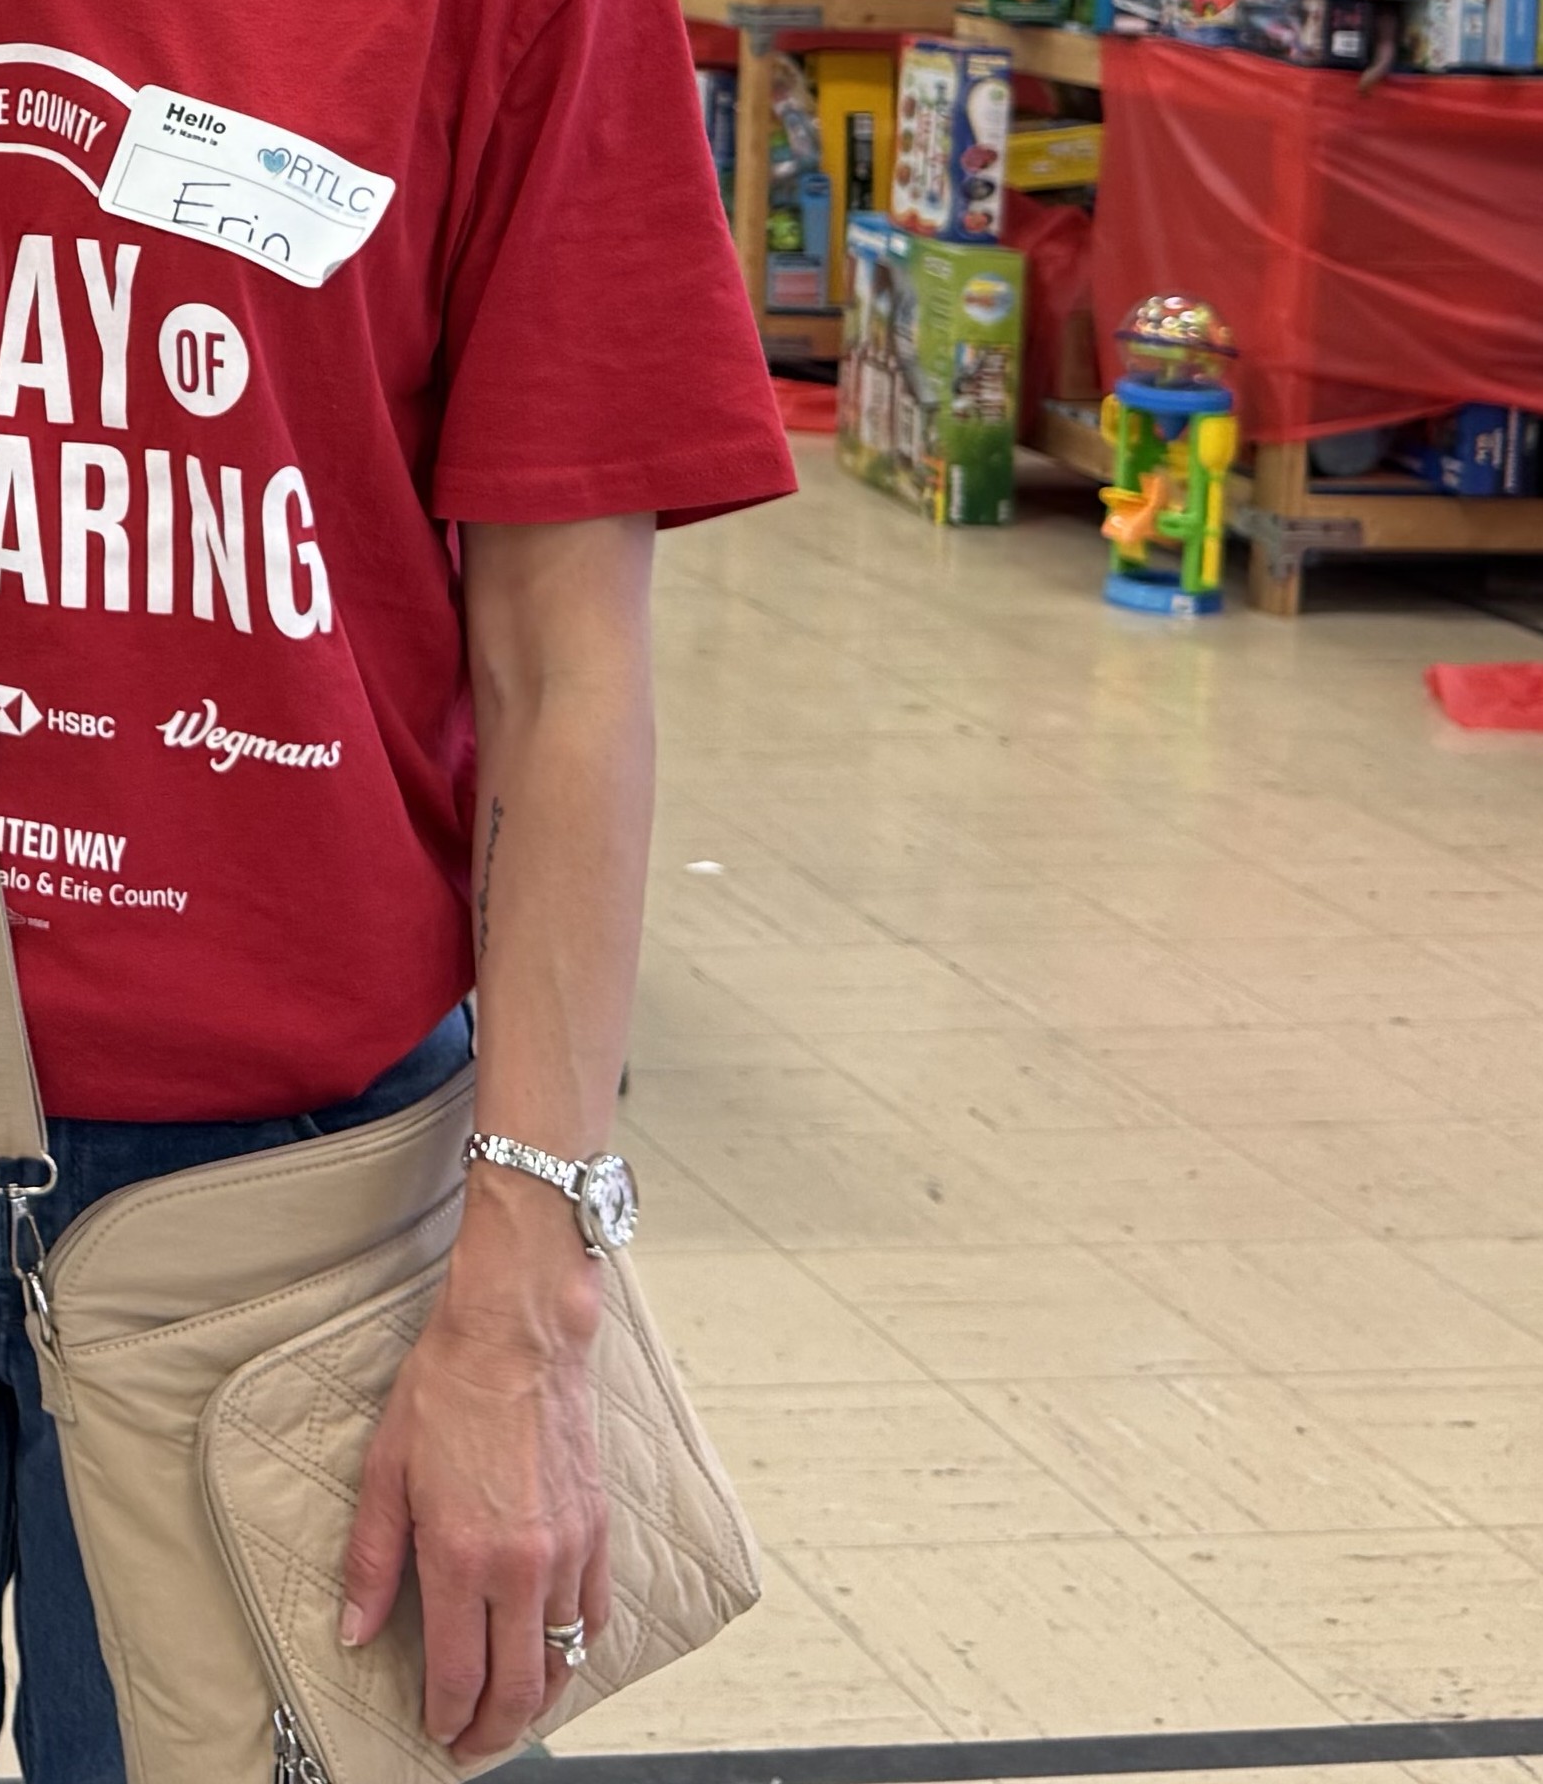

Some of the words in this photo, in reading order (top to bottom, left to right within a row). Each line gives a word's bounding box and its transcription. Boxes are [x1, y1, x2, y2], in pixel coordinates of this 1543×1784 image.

[16, 88, 107, 153] COUNTY
[165, 103, 226, 135] Hello
[288, 153, 375, 214] RTLC
[172, 182, 291, 262] Erin
[175, 328, 224, 398] OF
[48, 708, 116, 739] HSBC
[155, 697, 342, 774] Wegmans
[65, 827, 126, 873] WAY
[36, 872, 54, 895] &
[60, 877, 103, 905] Erie
[111, 879, 187, 913] County
